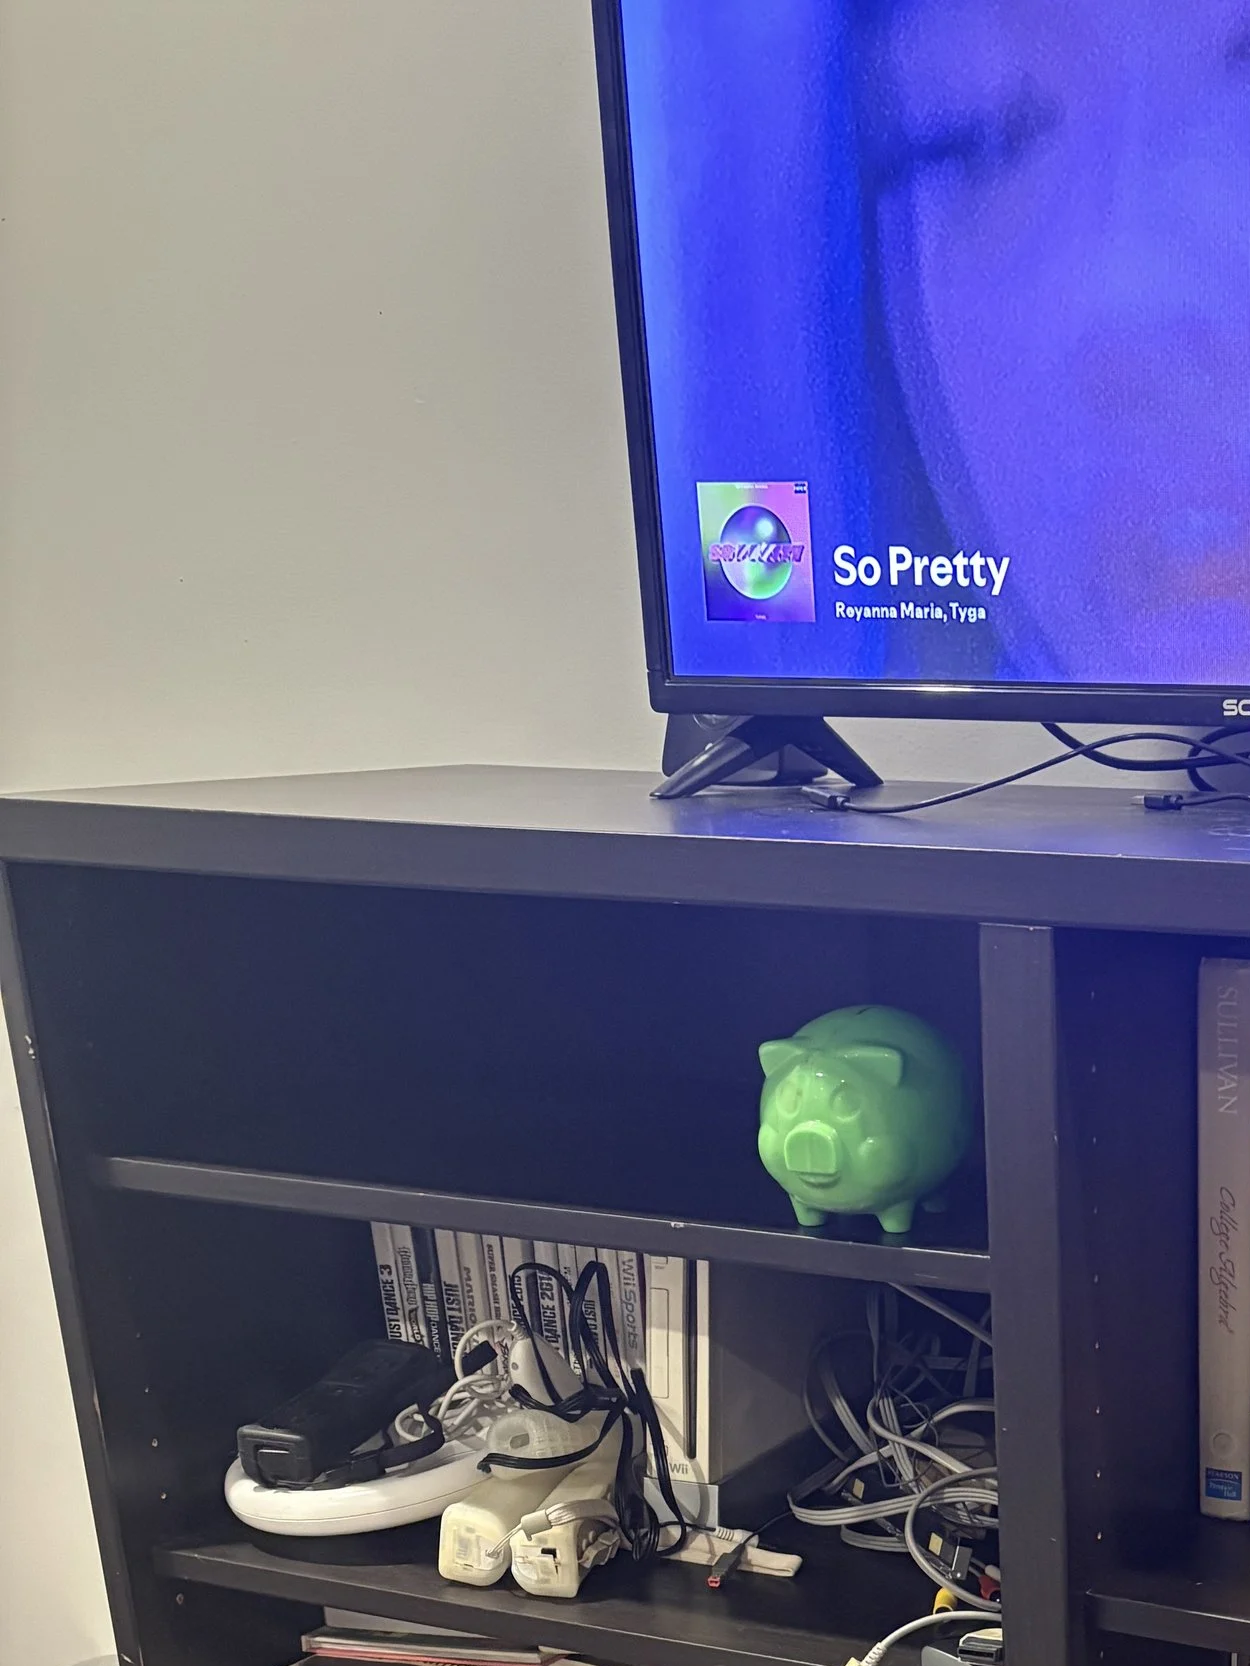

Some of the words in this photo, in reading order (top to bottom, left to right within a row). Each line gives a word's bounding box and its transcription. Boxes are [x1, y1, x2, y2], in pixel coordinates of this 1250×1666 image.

[833, 545, 881, 587] So
[889, 545, 1010, 596] Pretty
[900, 602, 947, 624] Maria,
[949, 602, 986, 624] Tyga
[1217, 985, 1239, 1115] SULLIVAN
[379, 1264, 393, 1276] 3
[620, 1257, 636, 1289] Wii
[380, 1278, 401, 1317] DANCE
[422, 1282, 437, 1302] HIP
[443, 1280, 463, 1314] JUST
[425, 1302, 440, 1322] HOP
[621, 1290, 639, 1351] Sports
[669, 1462, 689, 1475] Wii
